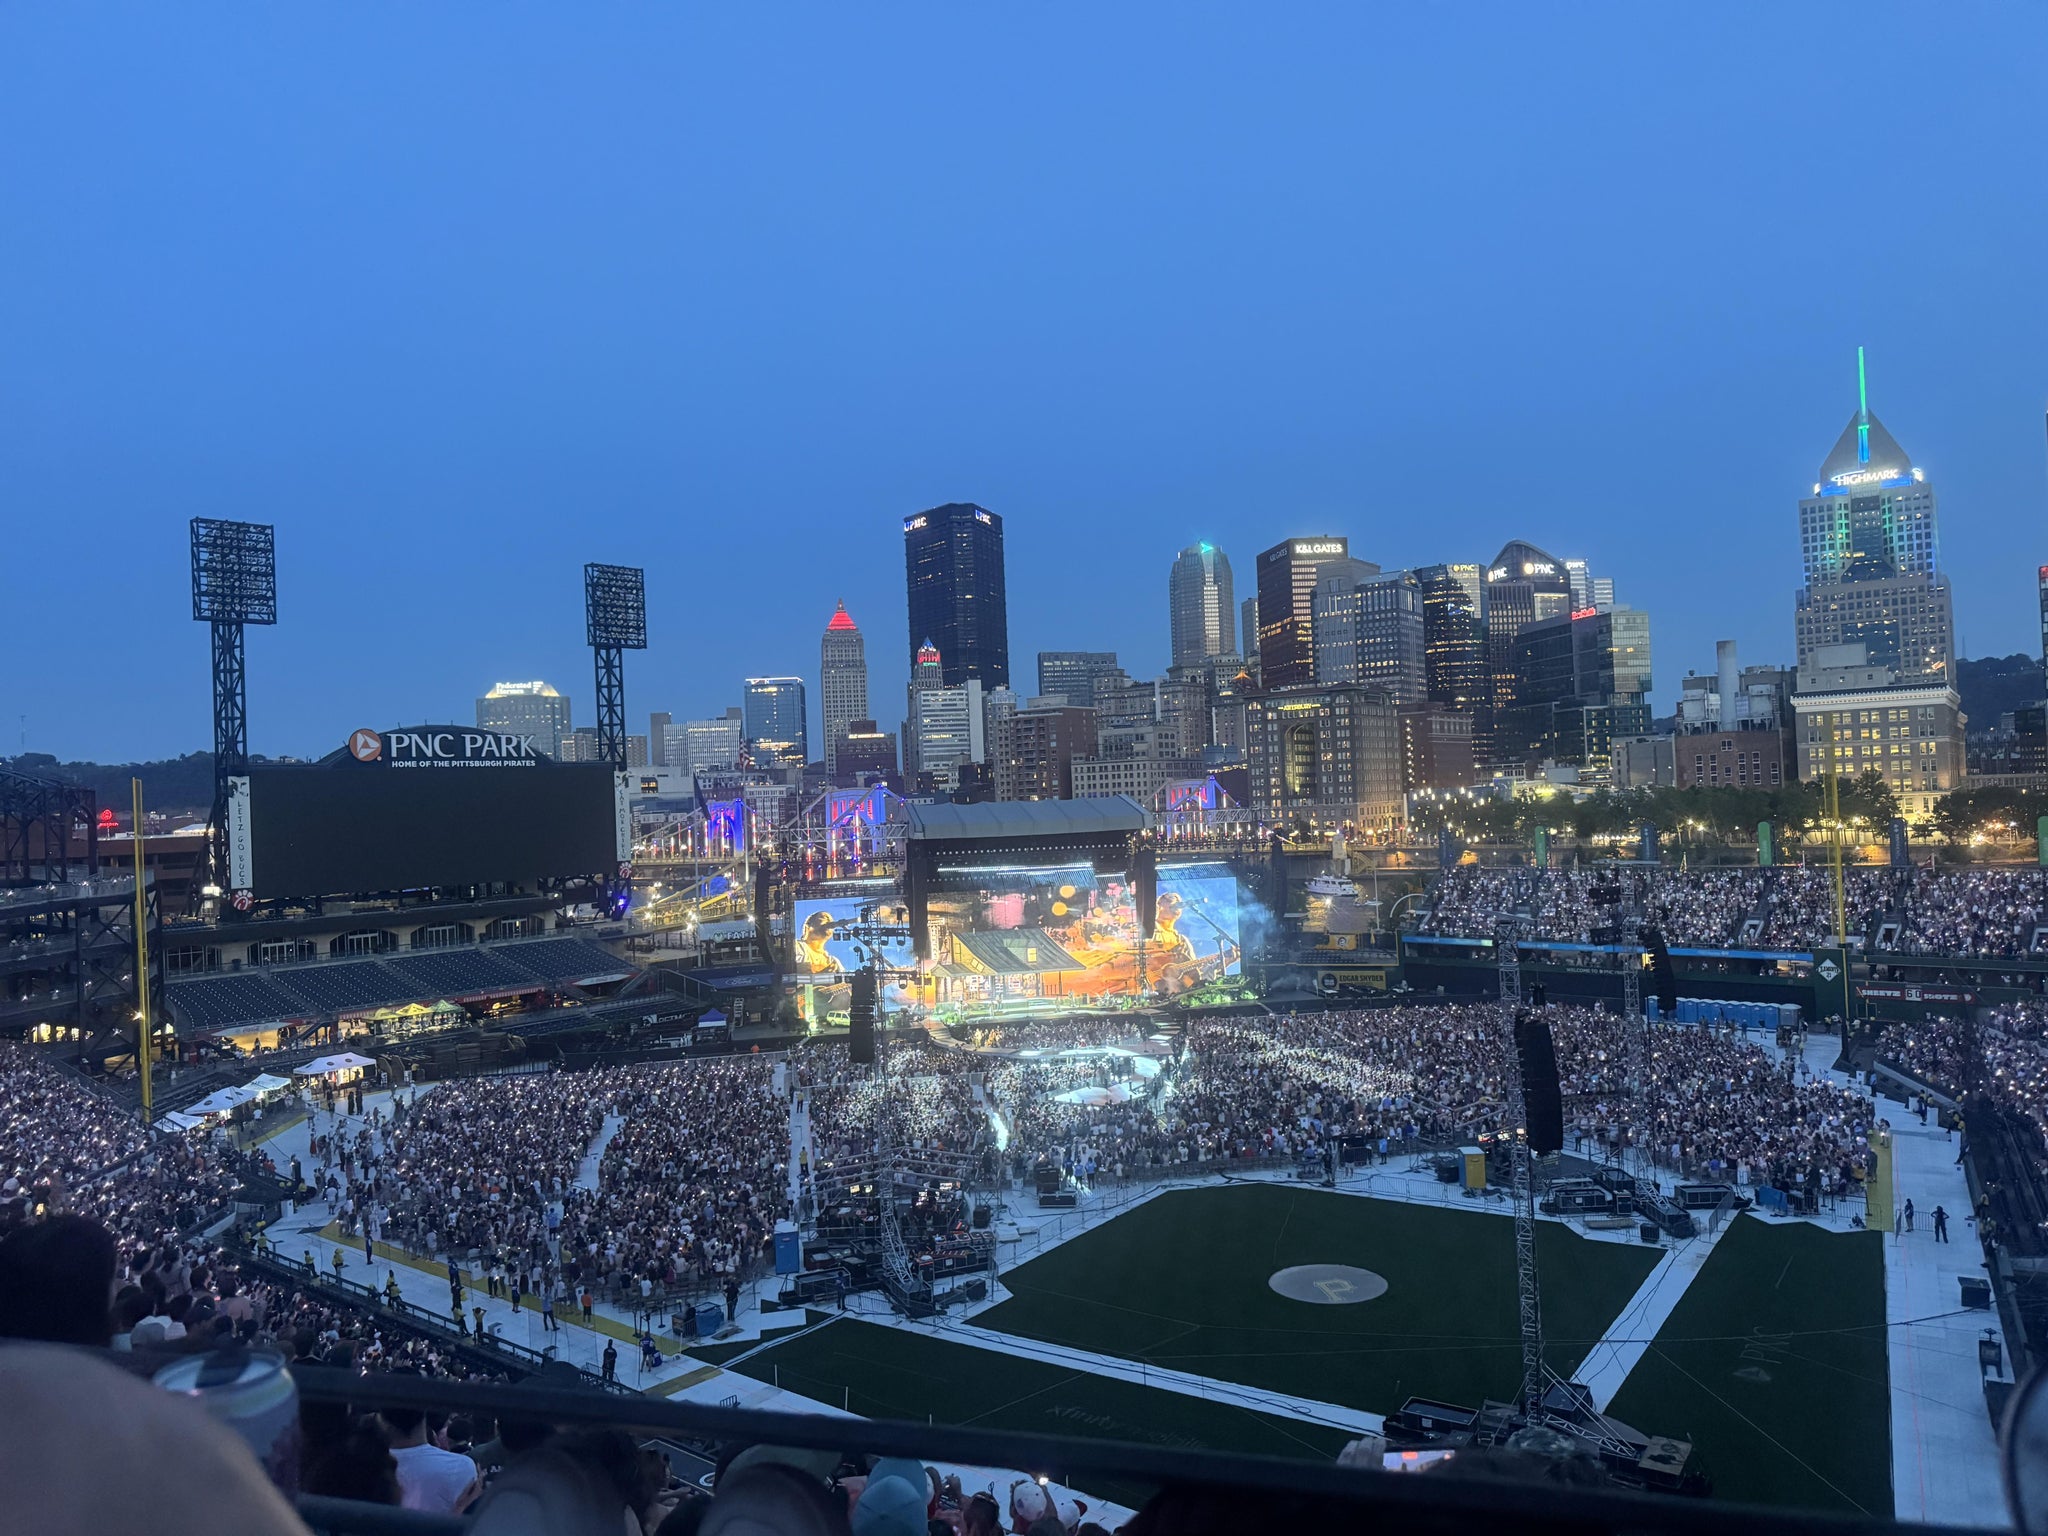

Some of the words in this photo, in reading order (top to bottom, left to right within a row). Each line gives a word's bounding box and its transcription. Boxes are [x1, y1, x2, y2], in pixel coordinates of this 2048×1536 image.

[1837, 469, 1898, 486] HIGHMARK
[904, 516, 928, 532] UPMC
[975, 509, 991, 525] UPMC
[1295, 544, 1313, 553] K&L
[1313, 543, 1343, 553] GATES
[1494, 567, 1508, 579] PNC
[1534, 564, 1555, 574] PNC
[387, 733, 455, 757] PNC
[461, 734, 536, 757] PARK
[391, 760, 417, 768] HOME
[238, 836, 244, 851] GO
